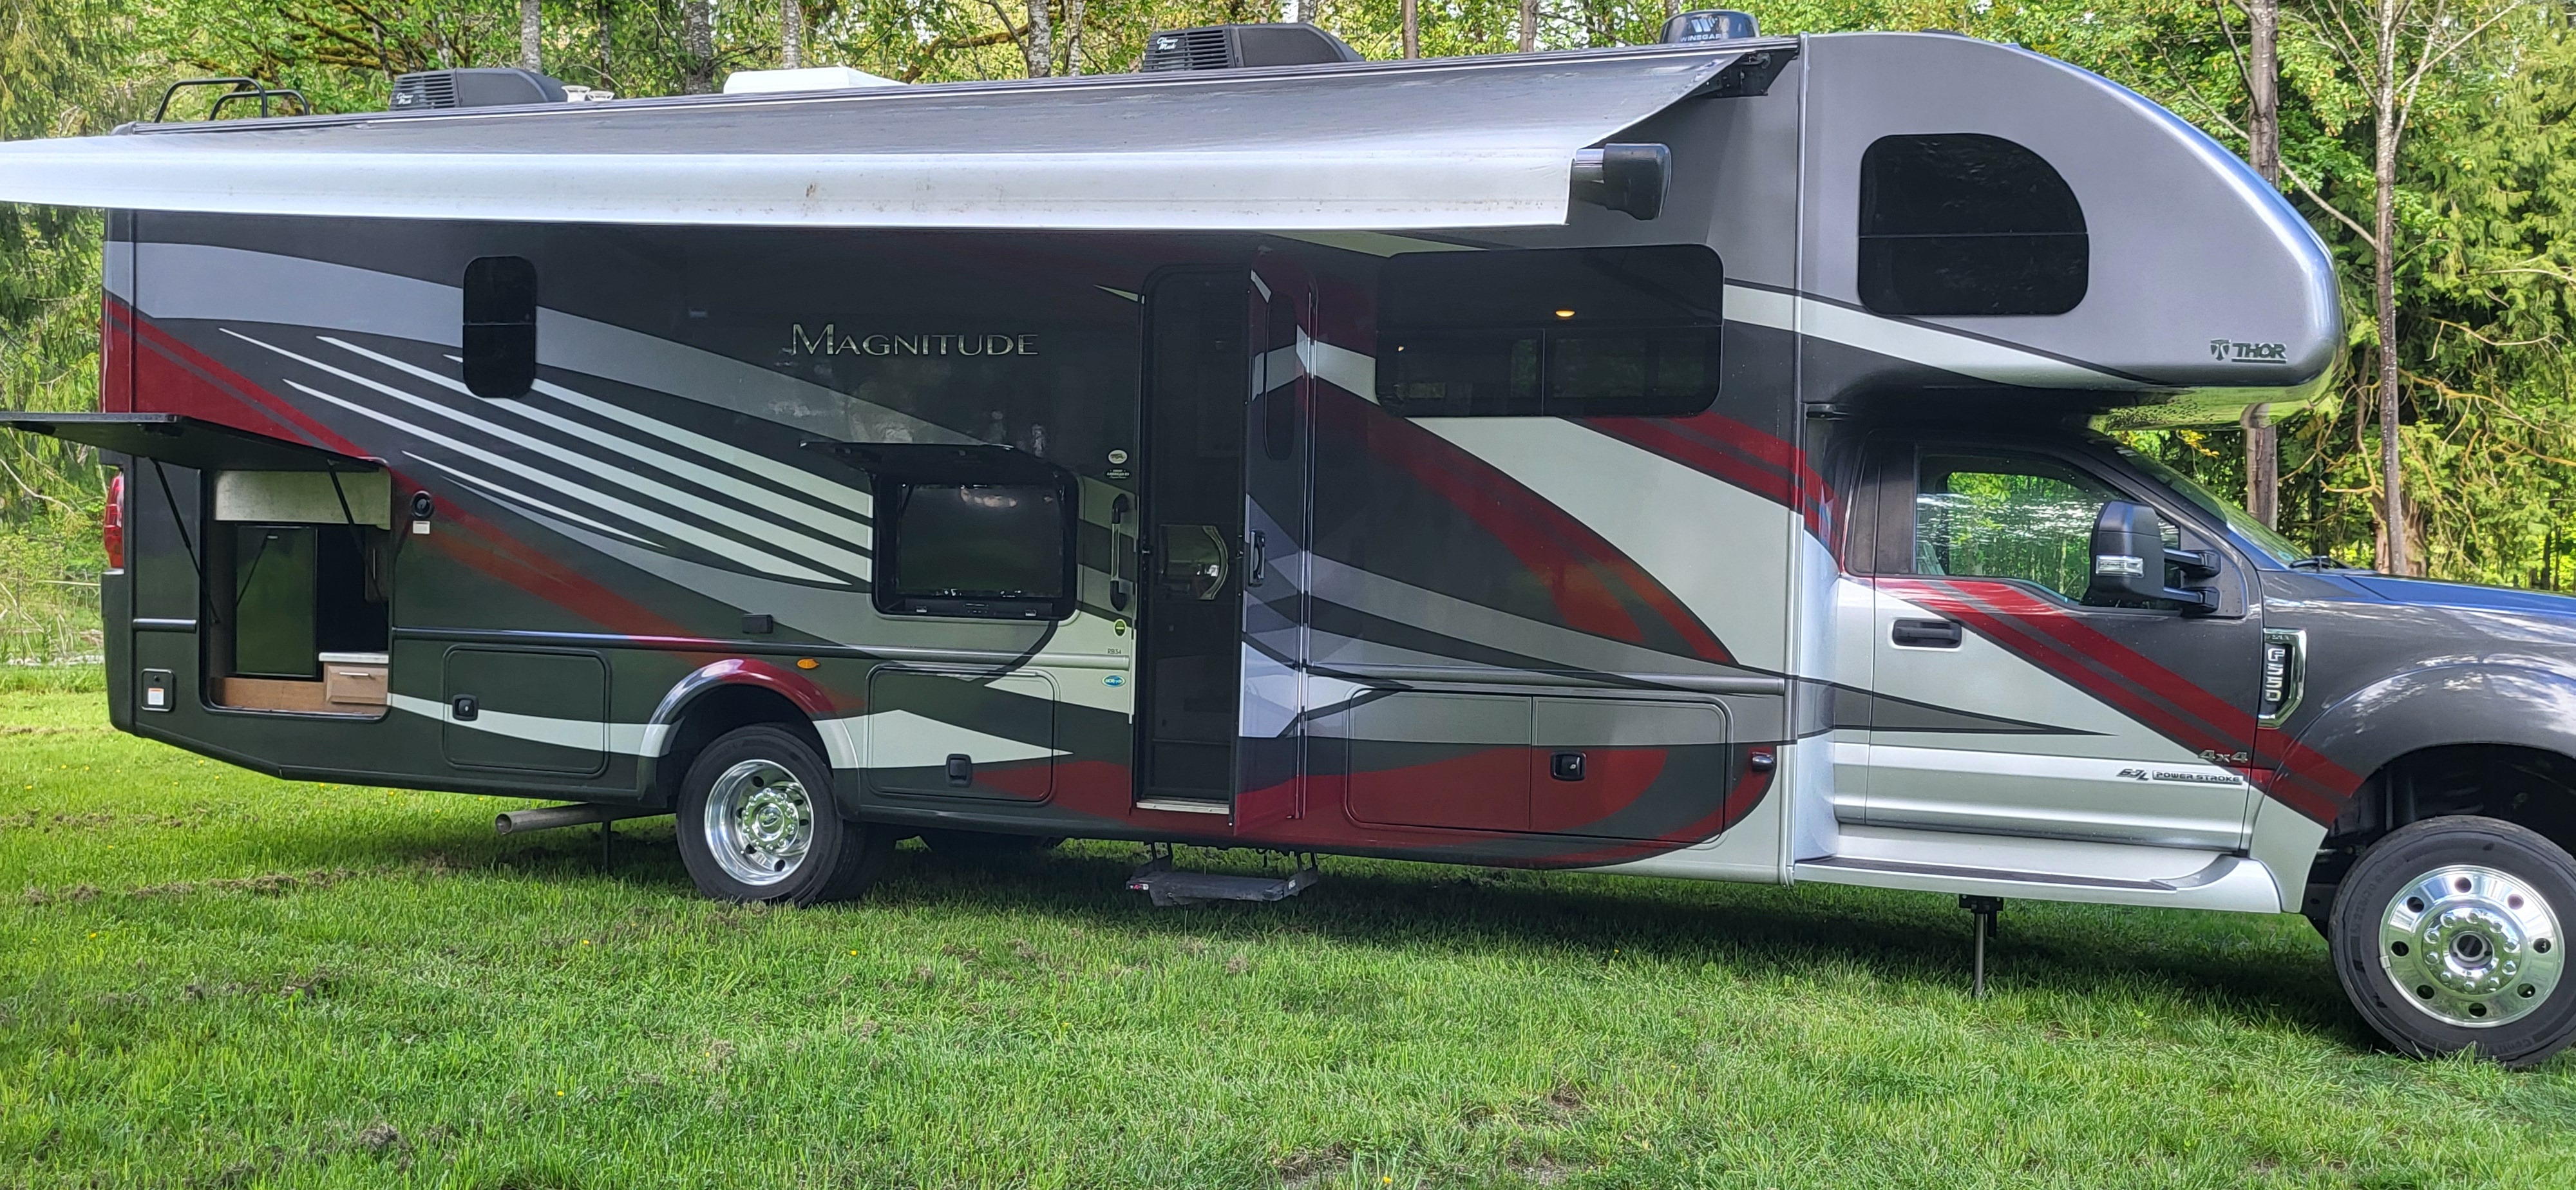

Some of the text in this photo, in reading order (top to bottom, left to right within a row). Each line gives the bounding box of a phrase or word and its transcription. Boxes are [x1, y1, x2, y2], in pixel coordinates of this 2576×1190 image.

[1680, 33, 1728, 42] WINEGAR
[791, 323, 1039, 355] MAGNITUDE
[2232, 343, 2286, 359] THOR
[2264, 648, 2286, 702] F550
[2198, 750, 2248, 764] 4x4
